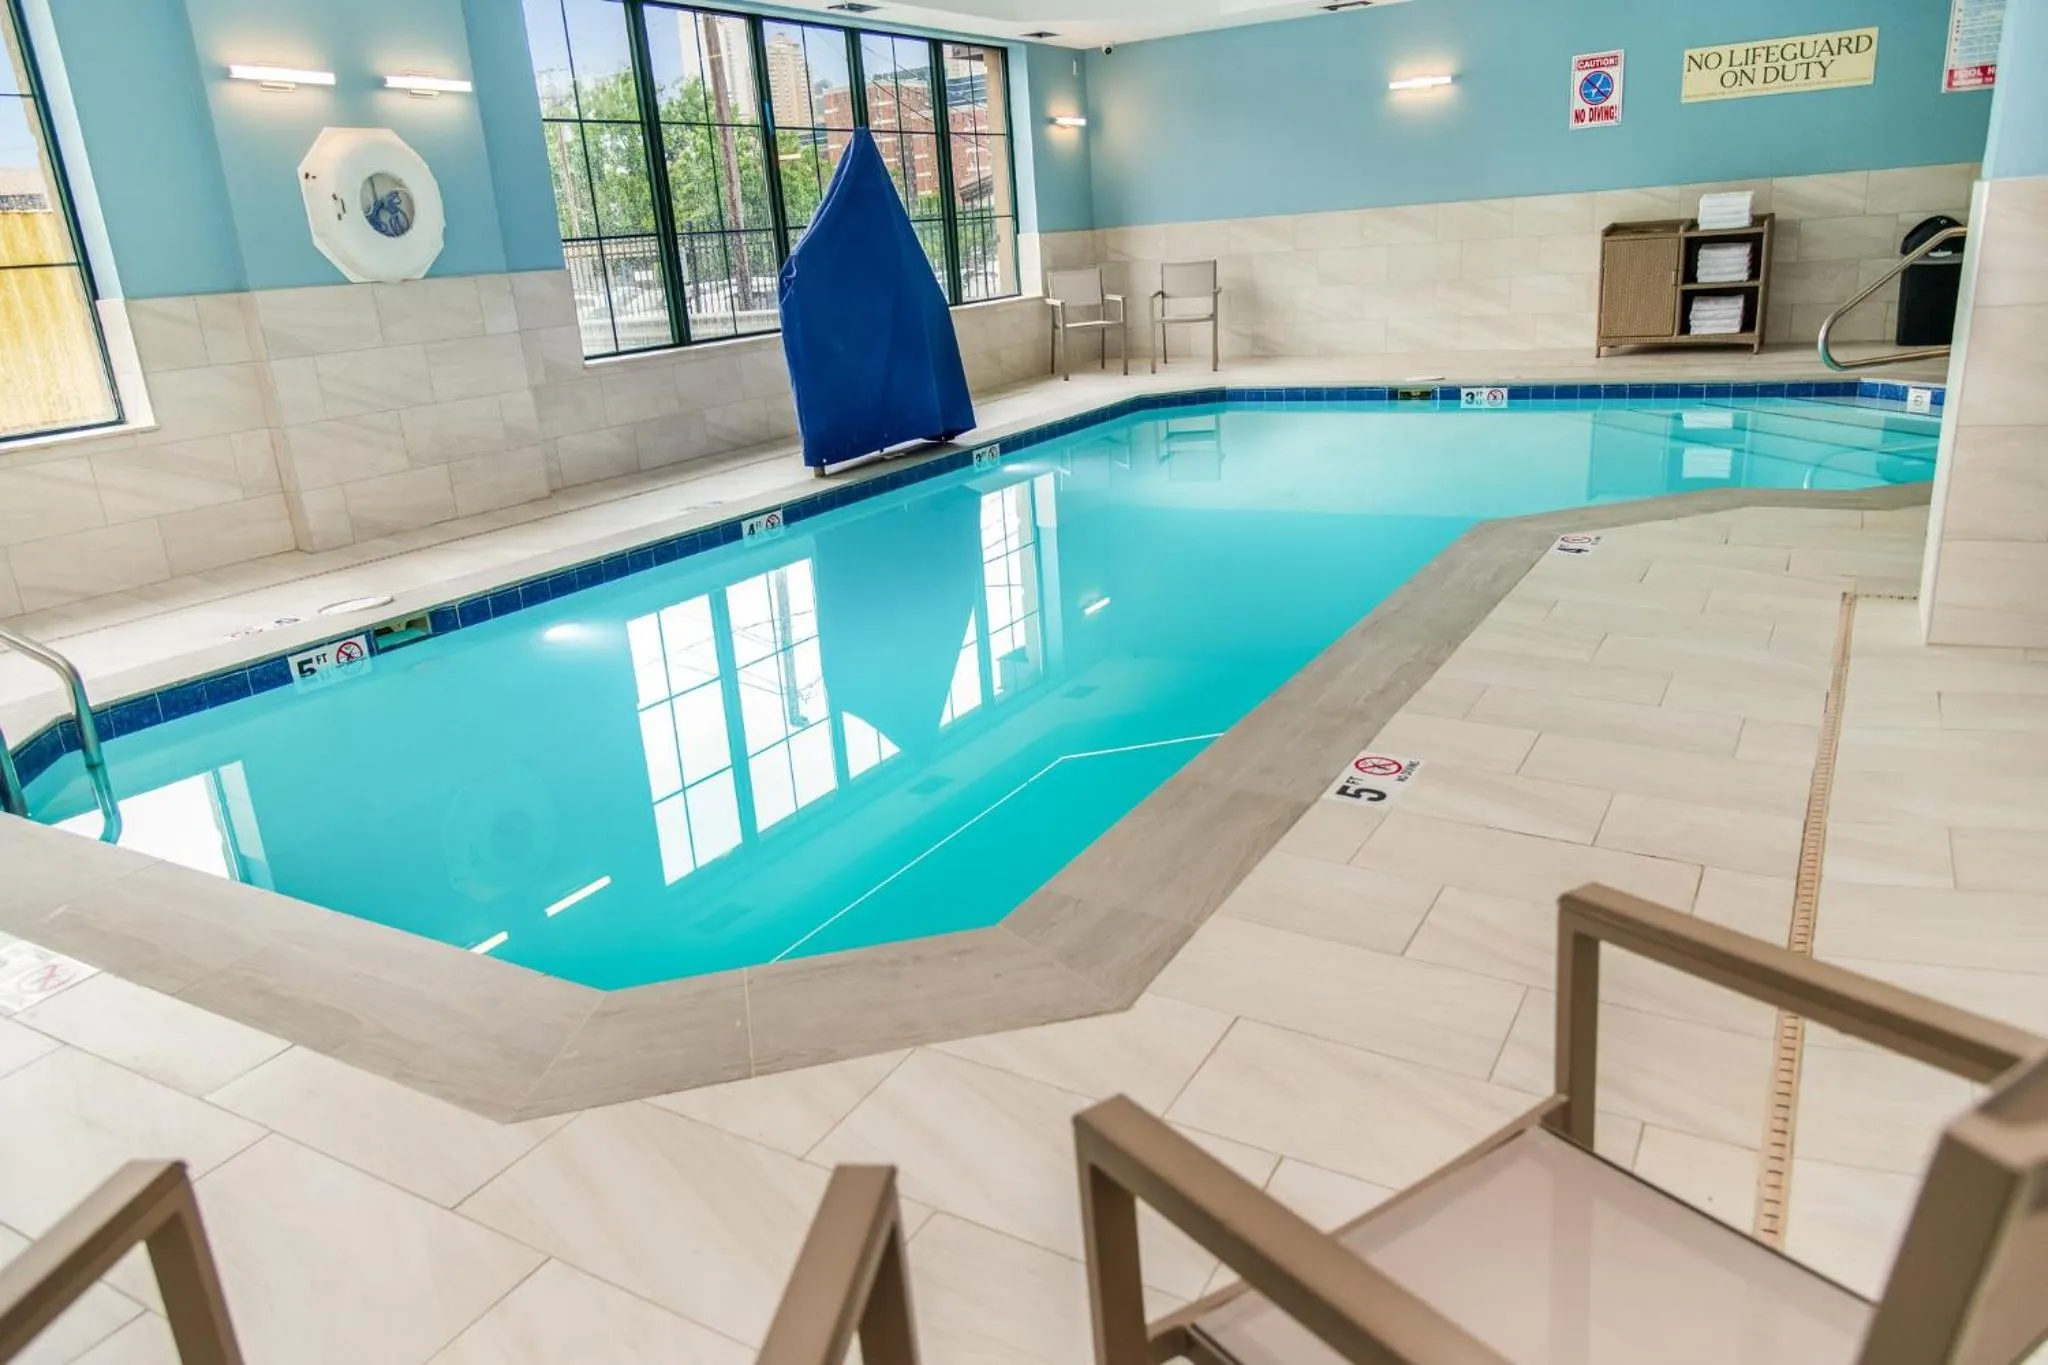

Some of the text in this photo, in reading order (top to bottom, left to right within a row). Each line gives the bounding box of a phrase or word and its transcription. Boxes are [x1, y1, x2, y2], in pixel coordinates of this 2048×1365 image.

[1686, 34, 1873, 73] NO LIFEGUARD
[1720, 67, 1756, 88] ON
[1763, 59, 1835, 84] DUTY
[1574, 105, 1618, 124] NO DIVING!
[1465, 391, 1475, 404] 3
[297, 652, 328, 678] 5 FT
[1335, 775, 1387, 802] 5 FT
